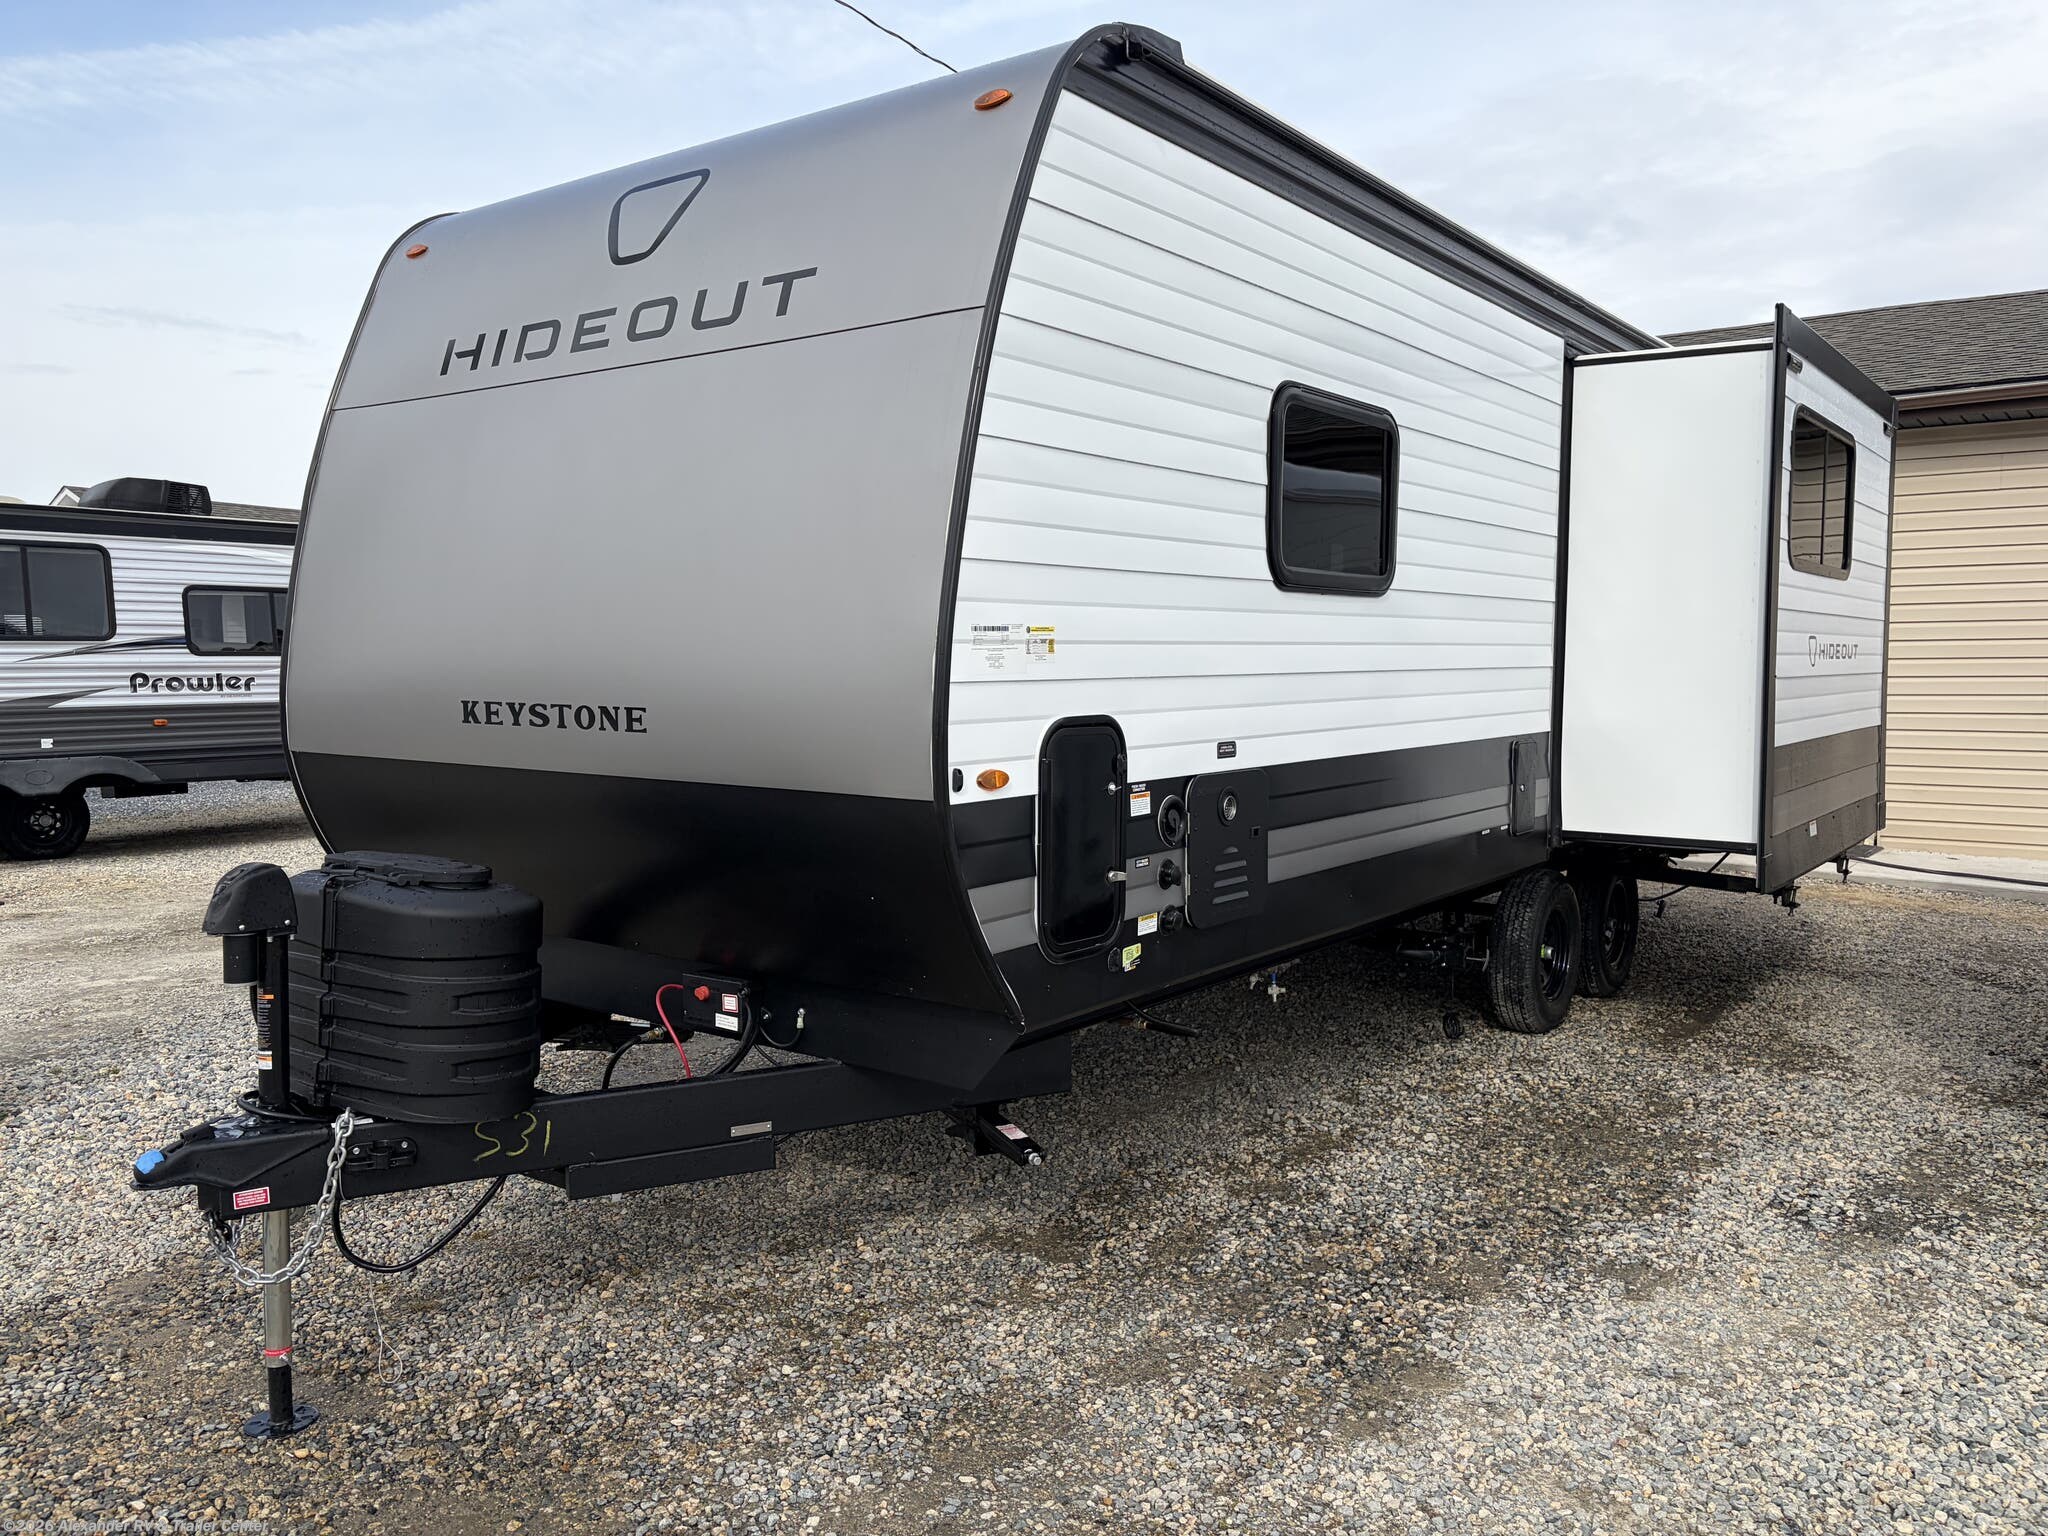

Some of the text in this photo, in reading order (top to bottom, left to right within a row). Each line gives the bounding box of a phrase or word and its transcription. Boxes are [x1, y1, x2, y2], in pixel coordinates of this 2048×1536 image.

[439, 267, 818, 377] HIDEOUT
[1818, 643, 1858, 660] HIDEOUT
[129, 672, 256, 694] Prowler
[460, 700, 648, 734] KEYSTONE
